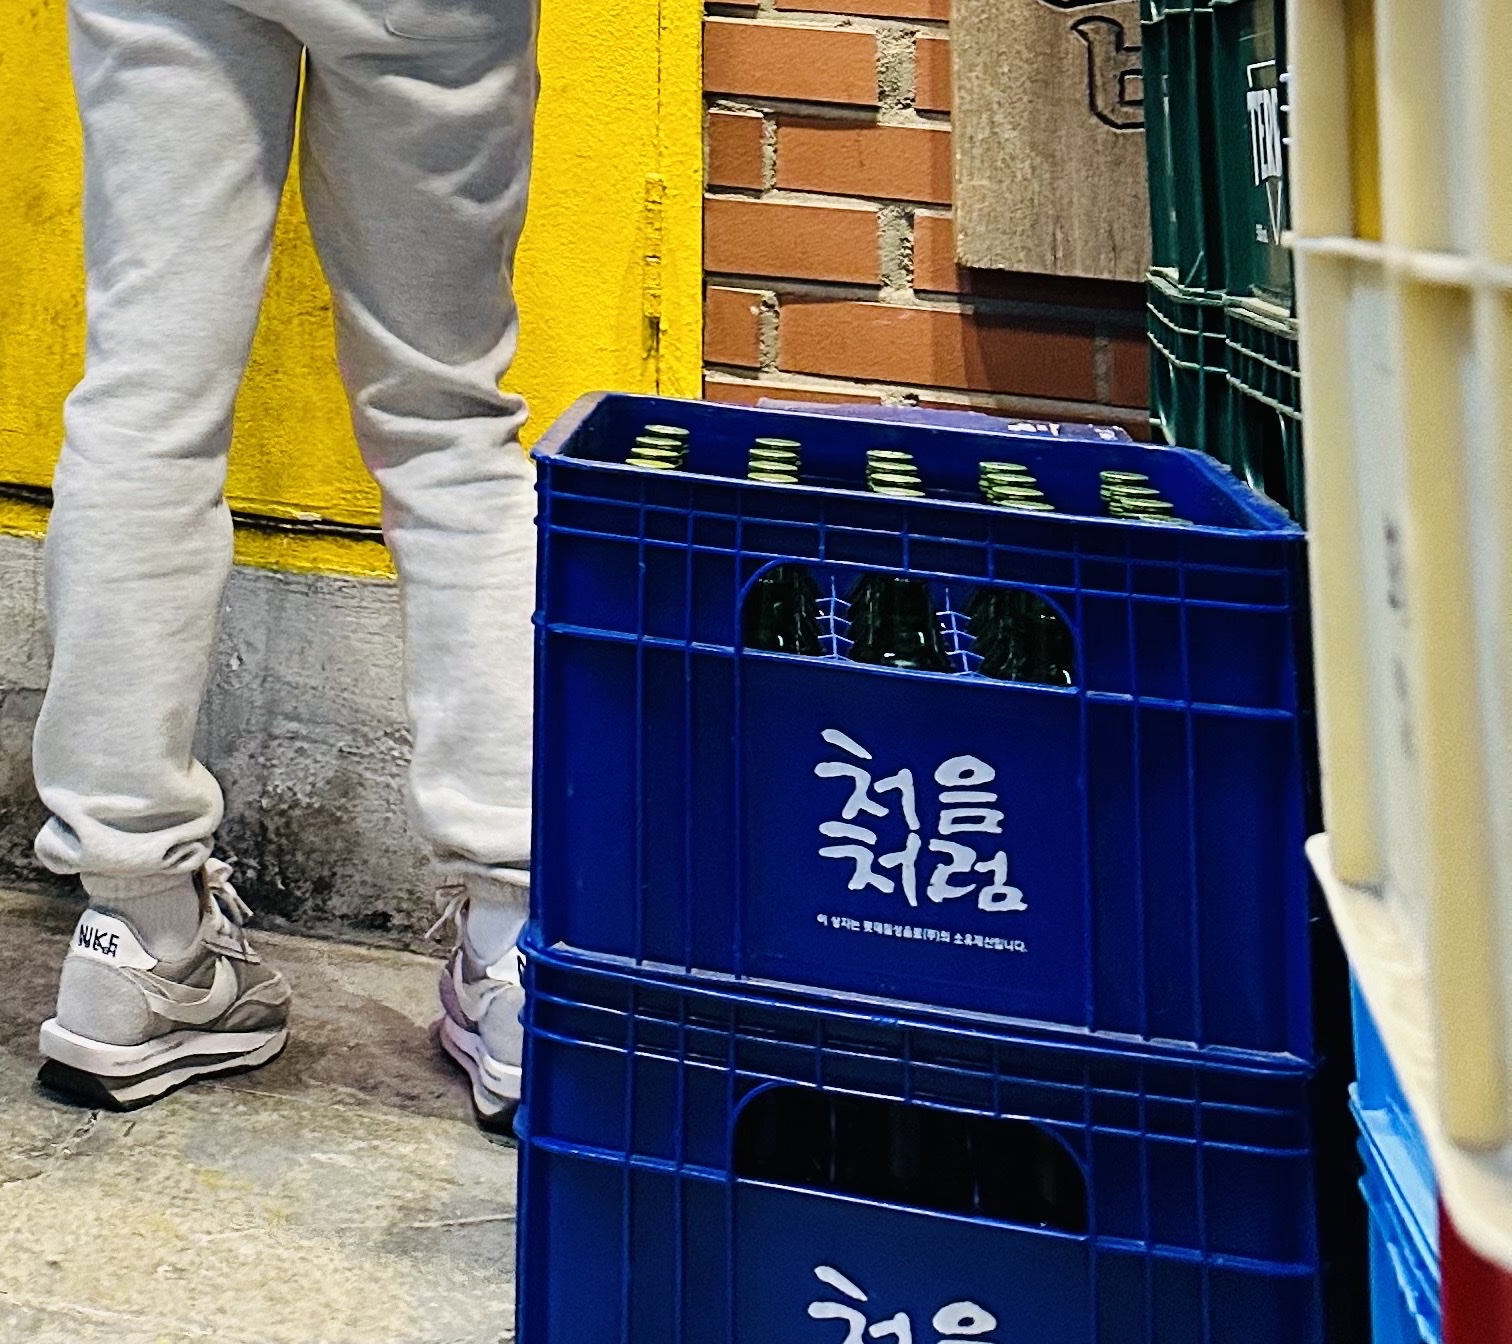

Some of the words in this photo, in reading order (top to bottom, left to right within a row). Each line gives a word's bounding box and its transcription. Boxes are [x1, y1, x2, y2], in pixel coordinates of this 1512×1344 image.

[812, 726, 1005, 837] 처음
[816, 819, 1029, 914] 처럼
[816, 913, 828, 926] 이
[830, 915, 861, 931] 상자는
[952, 931, 1029, 953] 소유재산입니다.
